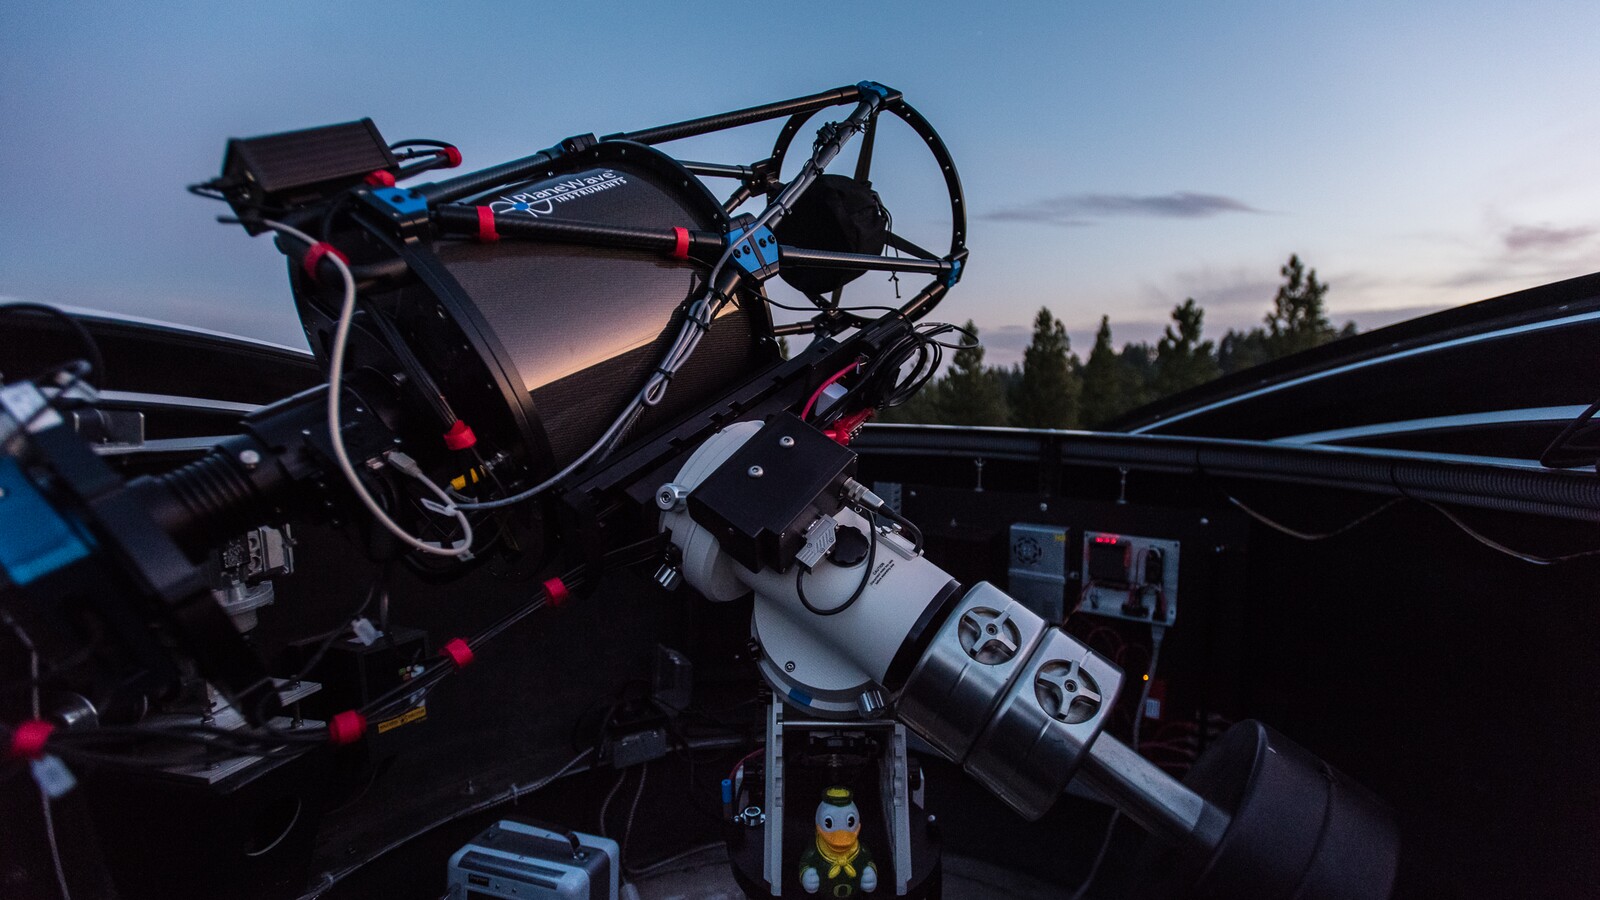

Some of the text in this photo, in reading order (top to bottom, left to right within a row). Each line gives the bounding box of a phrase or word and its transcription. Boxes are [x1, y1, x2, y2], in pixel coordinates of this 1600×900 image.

[512, 170, 617, 203] PlaneWave
[555, 176, 627, 203] INSTRUMENTS
[833, 883, 853, 898] O
